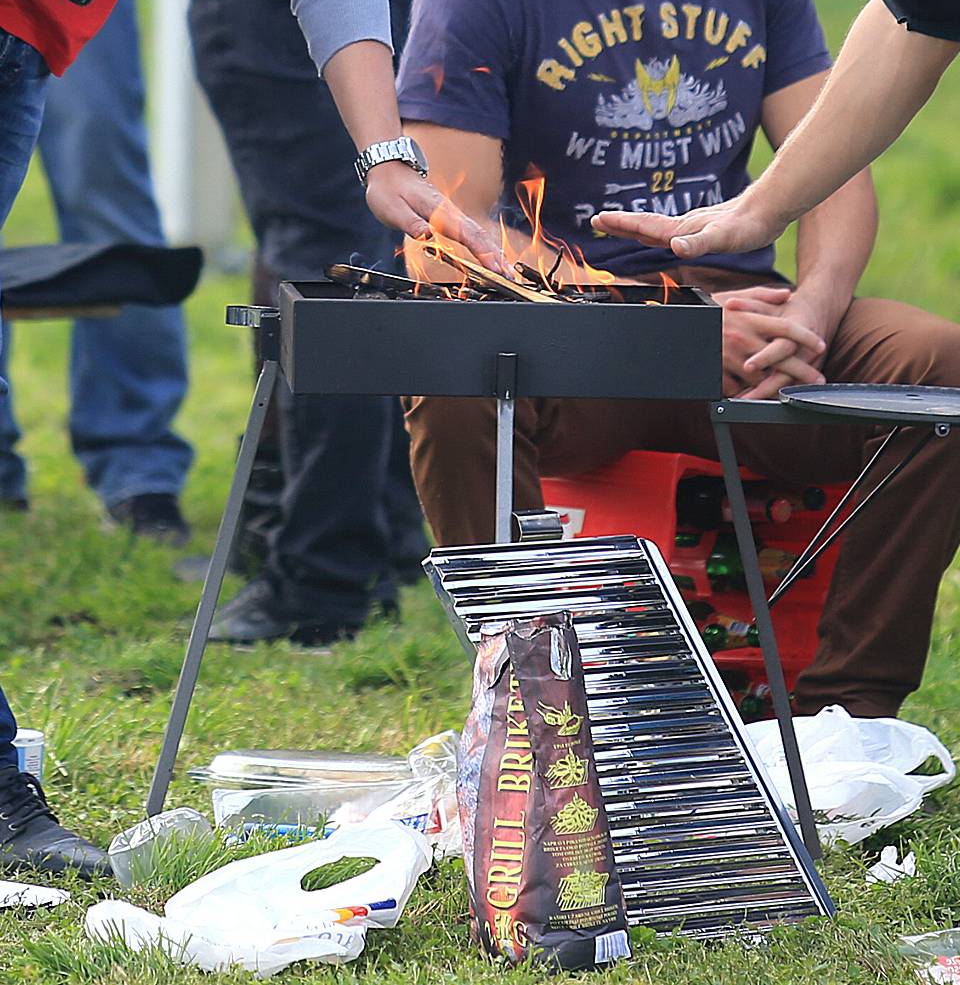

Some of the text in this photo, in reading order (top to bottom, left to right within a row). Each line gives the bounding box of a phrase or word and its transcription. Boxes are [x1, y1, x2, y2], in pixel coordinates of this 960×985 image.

[536, 1, 768, 91] RIGHT STUFF
[566, 111, 747, 171] WE MUST WIN
[650, 170, 674, 193] 22
[486, 809, 528, 909] GRILL
